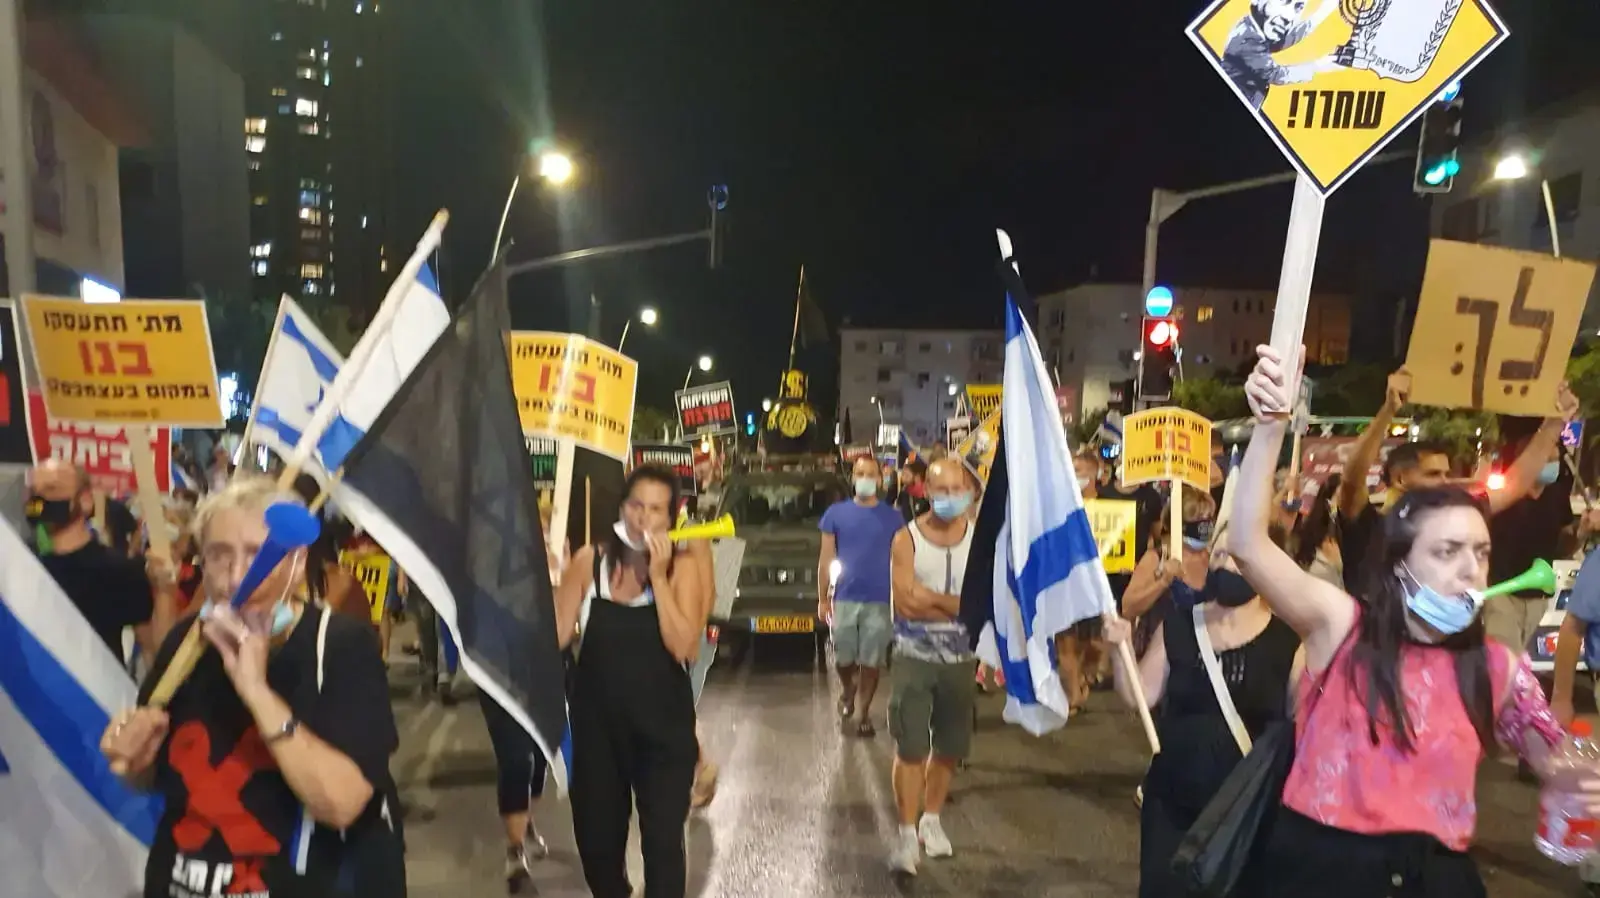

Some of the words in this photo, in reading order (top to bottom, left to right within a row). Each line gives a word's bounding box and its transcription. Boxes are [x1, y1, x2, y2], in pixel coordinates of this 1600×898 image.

[1287, 90, 1386, 129] שחרר!
[43, 311, 128, 333] תתעסקו
[137, 314, 183, 333] מתי
[79, 339, 153, 377] בנו
[146, 385, 210, 400] במקום
[50, 434, 156, 473] ביתה
